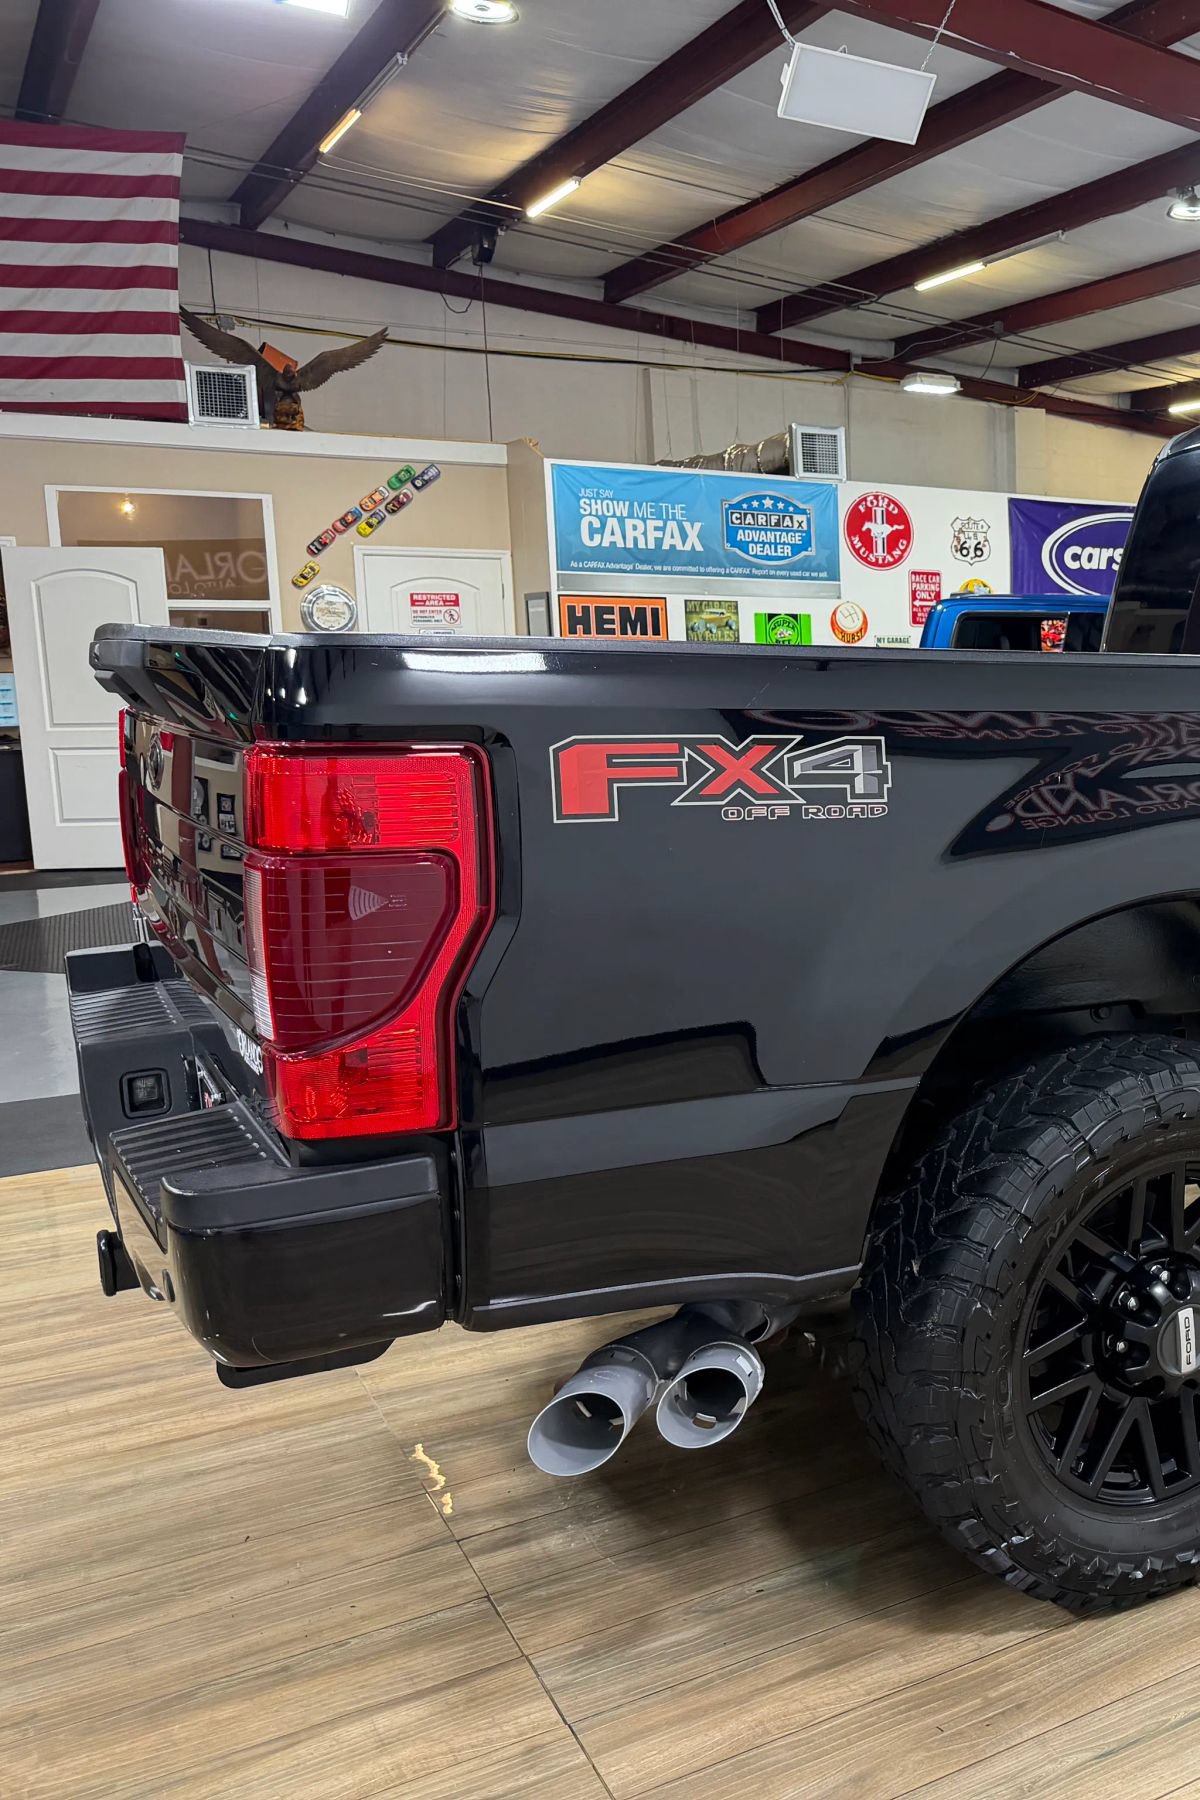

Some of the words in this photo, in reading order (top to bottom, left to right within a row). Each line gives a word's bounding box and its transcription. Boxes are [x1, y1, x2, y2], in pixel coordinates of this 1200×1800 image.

[579, 488, 597, 498] JUST
[599, 489, 614, 499] SAY
[579, 499, 629, 517] SHOW
[633, 502, 657, 519] ME
[659, 503, 687, 520] THE
[858, 495, 899, 515] FORD
[730, 512, 806, 530] CARFAX
[960, 521, 980, 531] ROUTE
[580, 515, 705, 552] CARFAX
[748, 543, 792, 557] DEALER
[851, 534, 908, 564] MUSTANG
[959, 540, 984, 558] 66
[570, 560, 578, 568] As
[672, 564, 699, 572] committed
[705, 566, 725, 575] offering
[752, 567, 769, 576] Report
[790, 569, 802, 577] used
[911, 574, 927, 583] RACE
[928, 575, 940, 583] CAR
[911, 583, 940, 592] PARKING
[915, 591, 936, 600] ONLY
[686, 601, 700, 612] MY
[702, 601, 738, 613] GARAGE
[566, 603, 664, 637] HEMI
[688, 630, 702, 642] MY
[839, 628, 864, 643] HURST
[887, 636, 911, 644] GARAGE
[549, 735, 892, 823] FX4
[721, 806, 790, 821] OFF
[802, 805, 889, 820] ROAD
[1184, 1316, 1193, 1366] FORD
